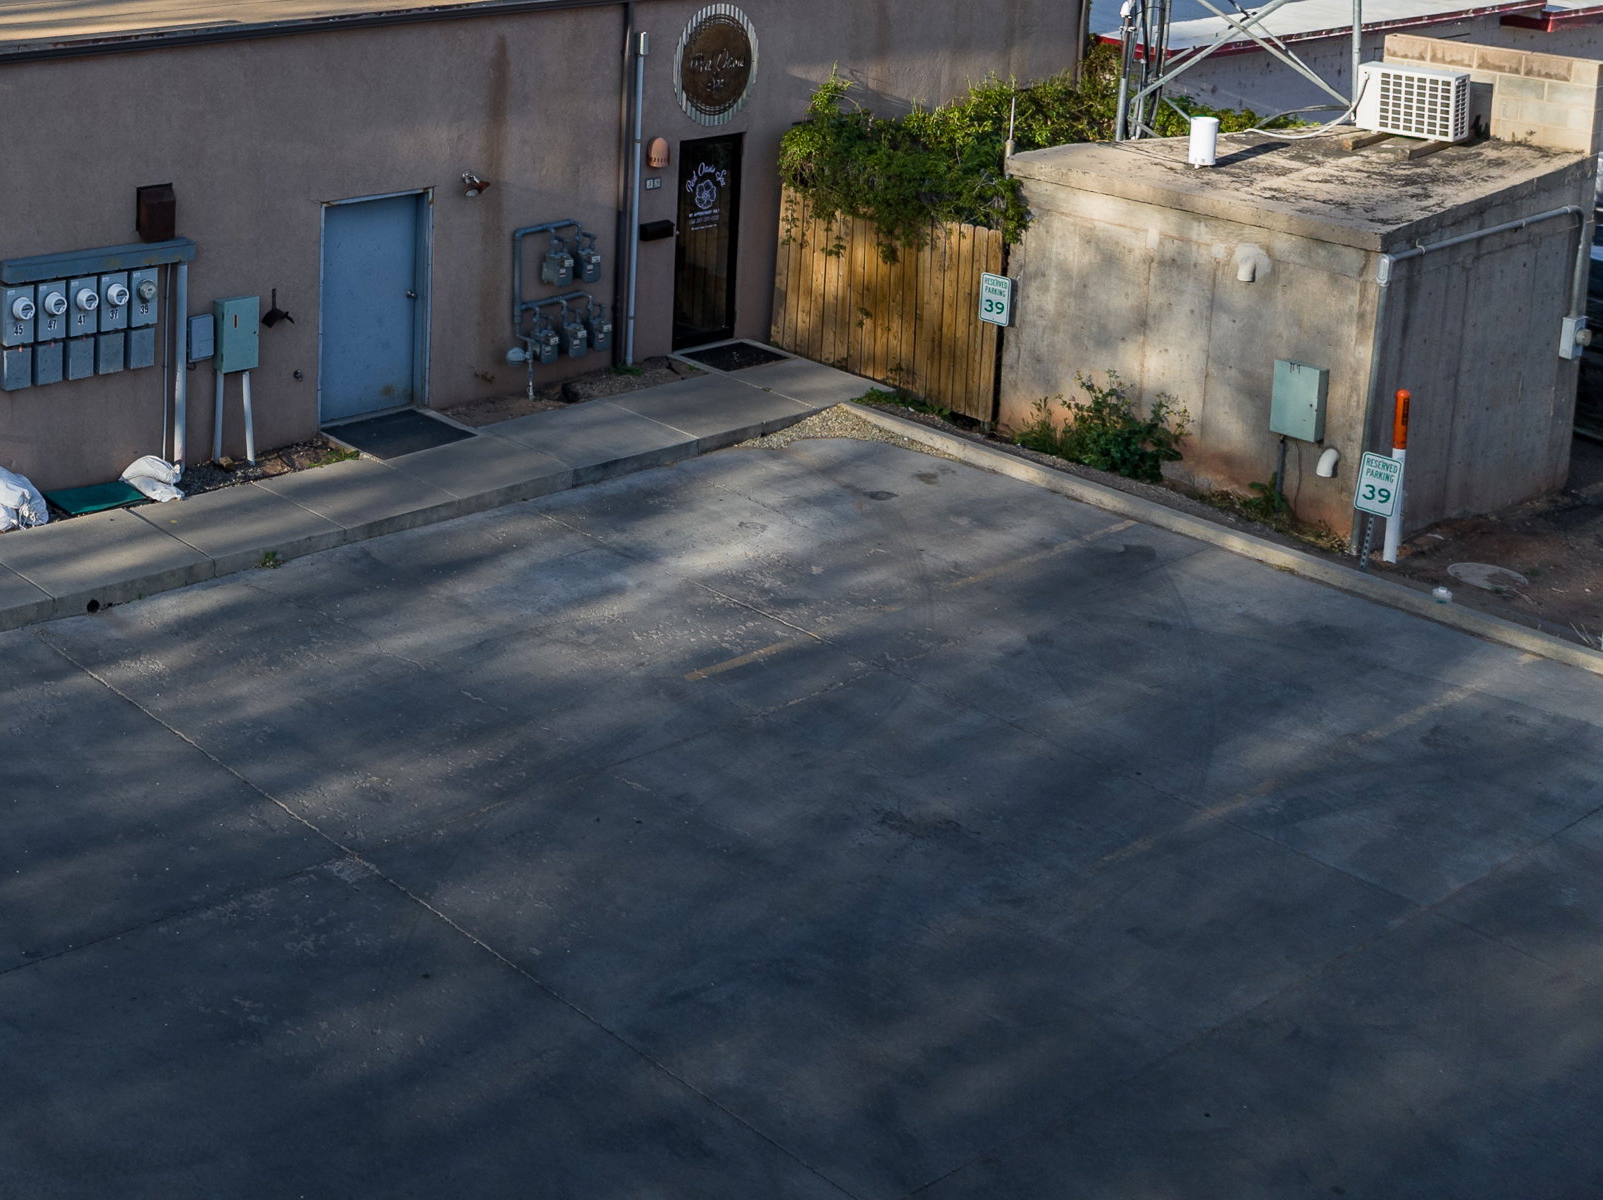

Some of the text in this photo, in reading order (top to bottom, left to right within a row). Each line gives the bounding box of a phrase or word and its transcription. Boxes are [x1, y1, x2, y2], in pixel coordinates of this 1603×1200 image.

[984, 276, 1008, 289] RESERVED
[984, 285, 1006, 298] PARKING
[140, 304, 150, 315] 39
[984, 299, 1005, 315] 39
[77, 314, 87, 325] 41
[109, 309, 119, 320] 37
[13, 325, 24, 336] 45
[47, 320, 58, 331] 47
[1365, 457, 1398, 474] RESERVED
[1365, 468, 1395, 484] PARKING
[1362, 484, 1391, 504] 39
